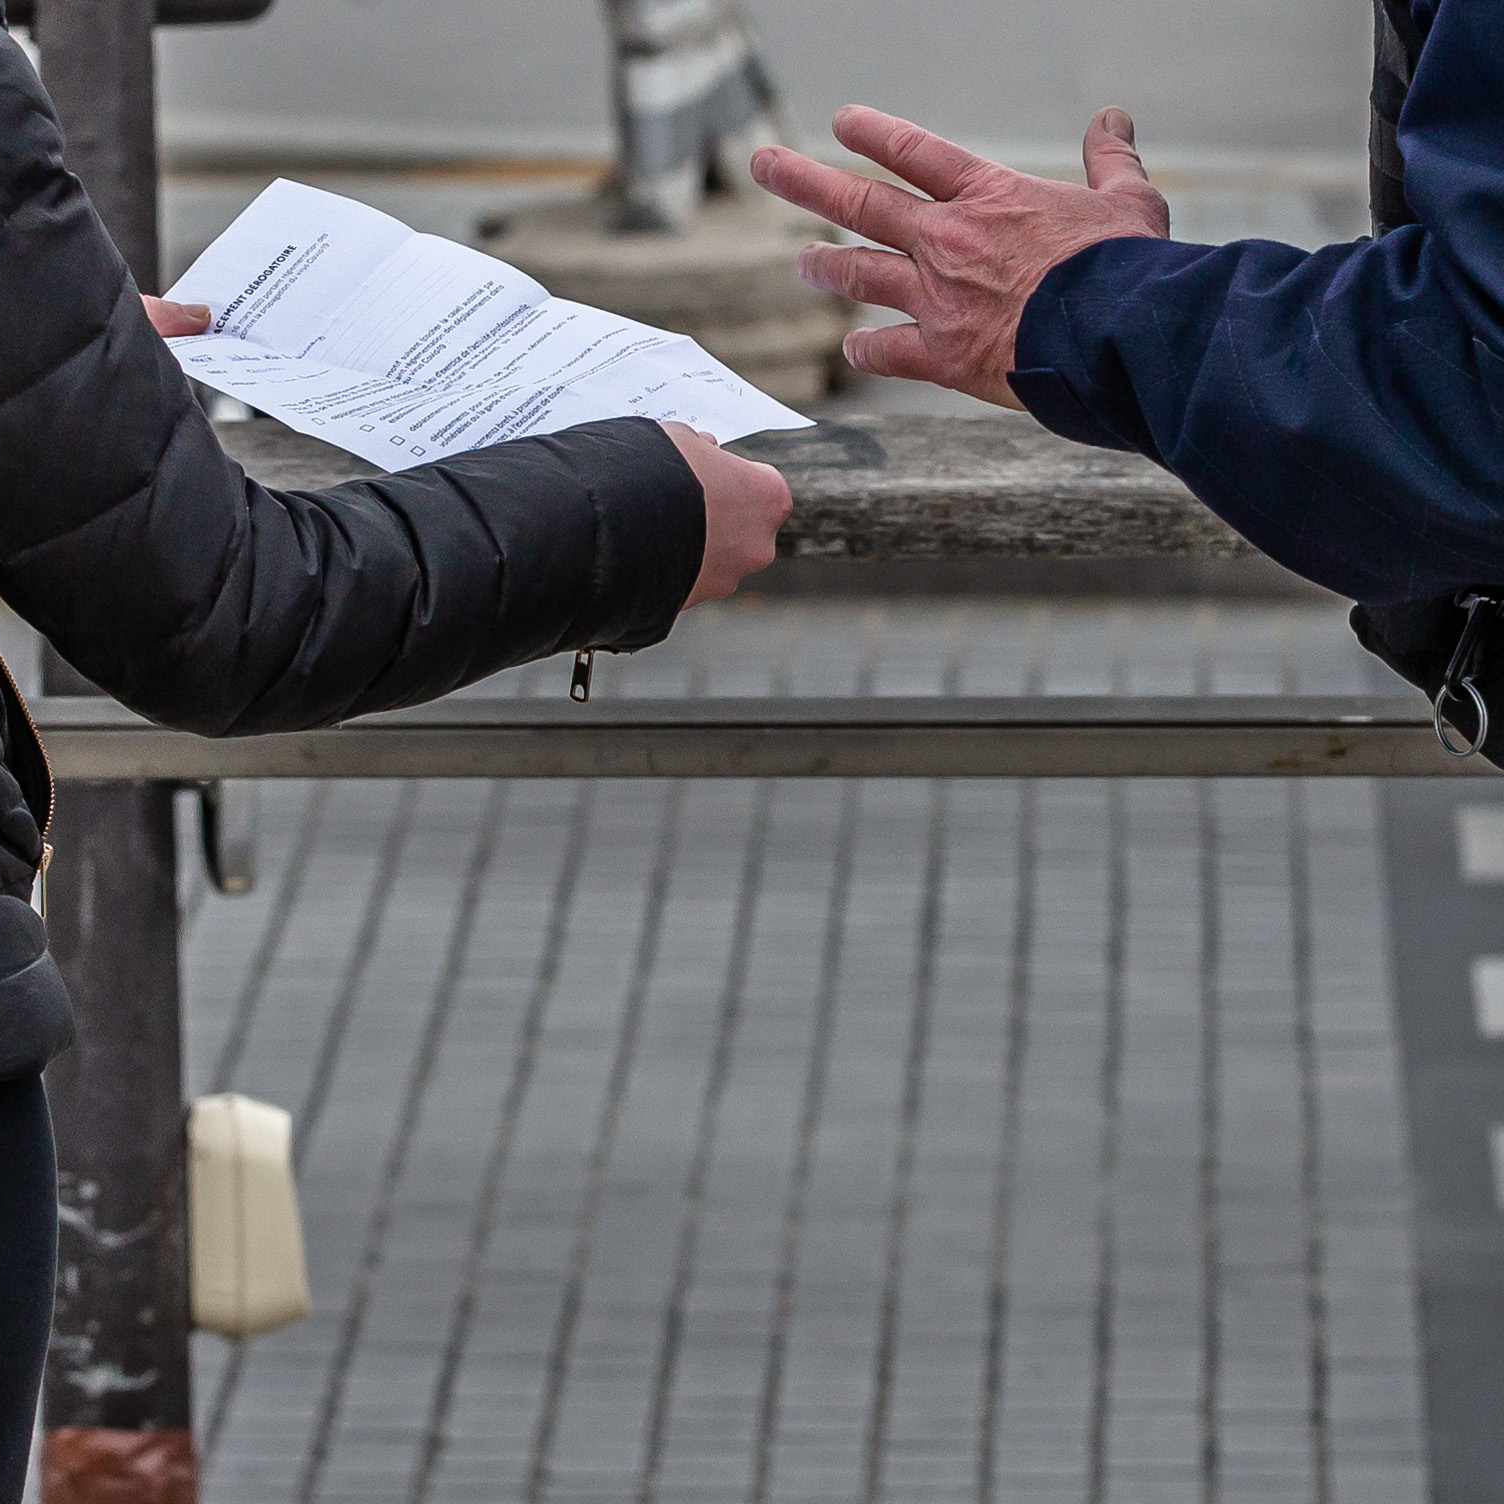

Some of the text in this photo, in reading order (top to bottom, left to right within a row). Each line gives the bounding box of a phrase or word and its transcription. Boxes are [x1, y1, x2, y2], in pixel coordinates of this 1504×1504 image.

[238, 311, 253, 326] mars
[249, 297, 266, 312] 2020
[263, 278, 284, 300] portant
[281, 242, 318, 280] réglementation
[244, 244, 297, 296] DÉROGATOIRE
[239, 318, 257, 340] contre
[260, 283, 291, 315] propagation
[296, 264, 310, 276] virus
[401, 341, 423, 360] suivant
[462, 288, 485, 307] autorisé
[404, 333, 446, 370] réglementation
[443, 325, 456, 334] des
[453, 295, 492, 326] déplacements
[408, 362, 425, 377] virus
[435, 356, 463, 377] d'exercice
[460, 350, 471, 359] de
[466, 333, 492, 353] l'activité
[512, 403, 543, 431] l'exclusion
[539, 397, 551, 407] de
[516, 389, 547, 413] proximité
[430, 410, 470, 442] déplacements
[439, 419, 473, 448] vulnérables
[470, 414, 481, 424] ou
